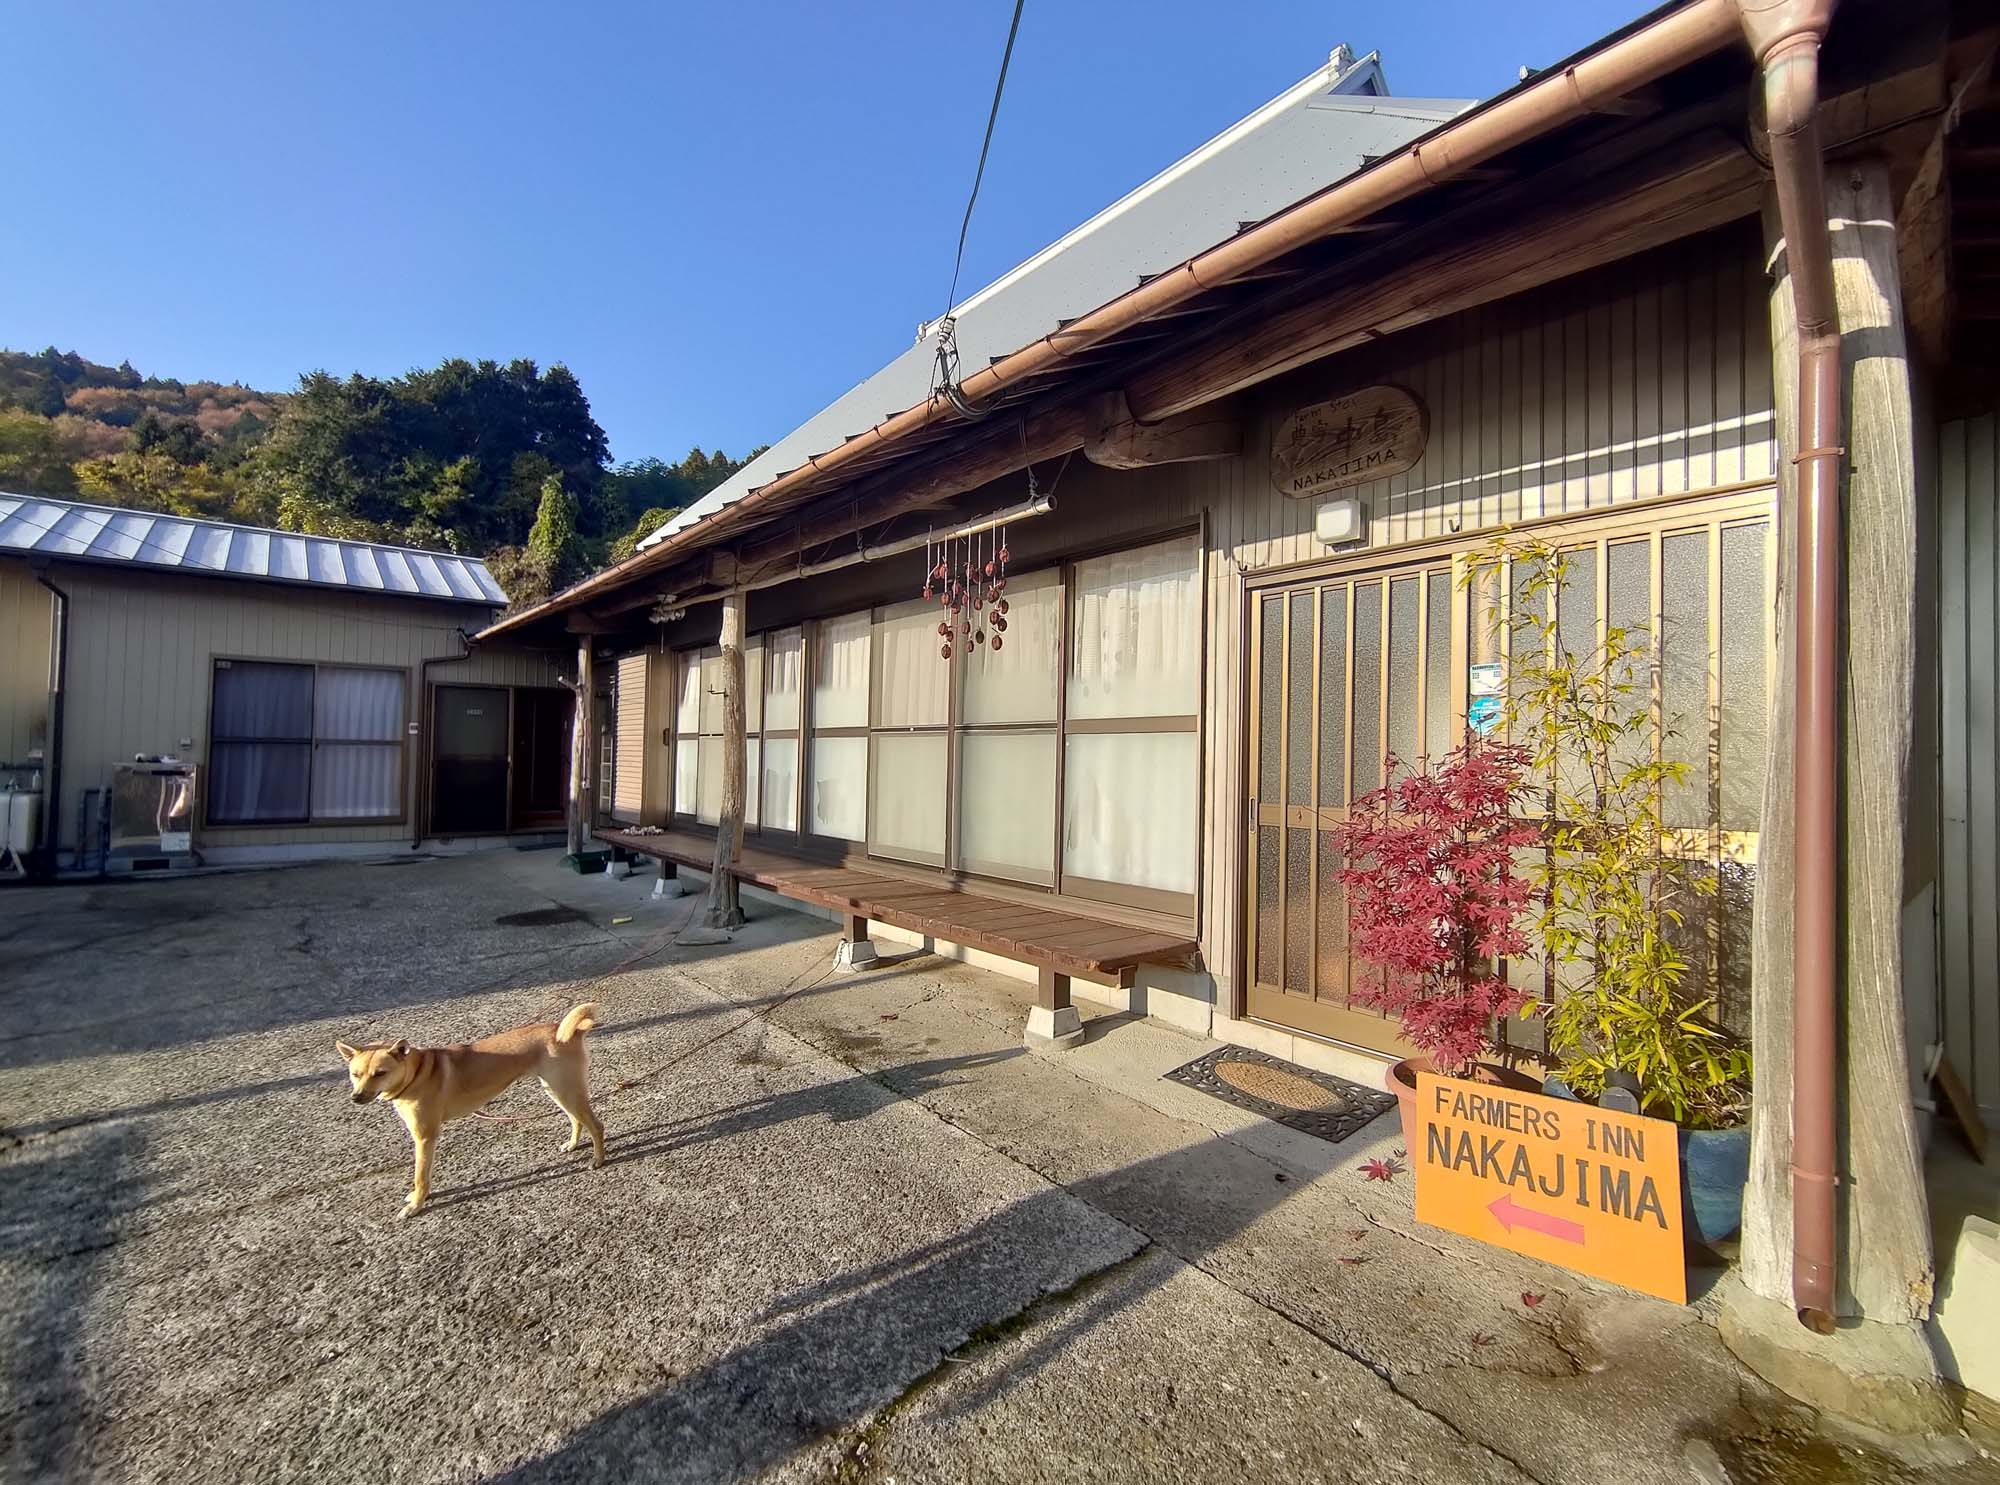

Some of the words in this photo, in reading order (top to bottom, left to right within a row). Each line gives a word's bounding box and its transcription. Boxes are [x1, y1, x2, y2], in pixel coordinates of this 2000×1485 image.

[1294, 449, 1397, 491] NAKAJIMA
[1435, 1086, 1561, 1141] FARMERS
[1586, 1118, 1645, 1162] INN
[1427, 1122, 1669, 1230] NAKAJIMA
